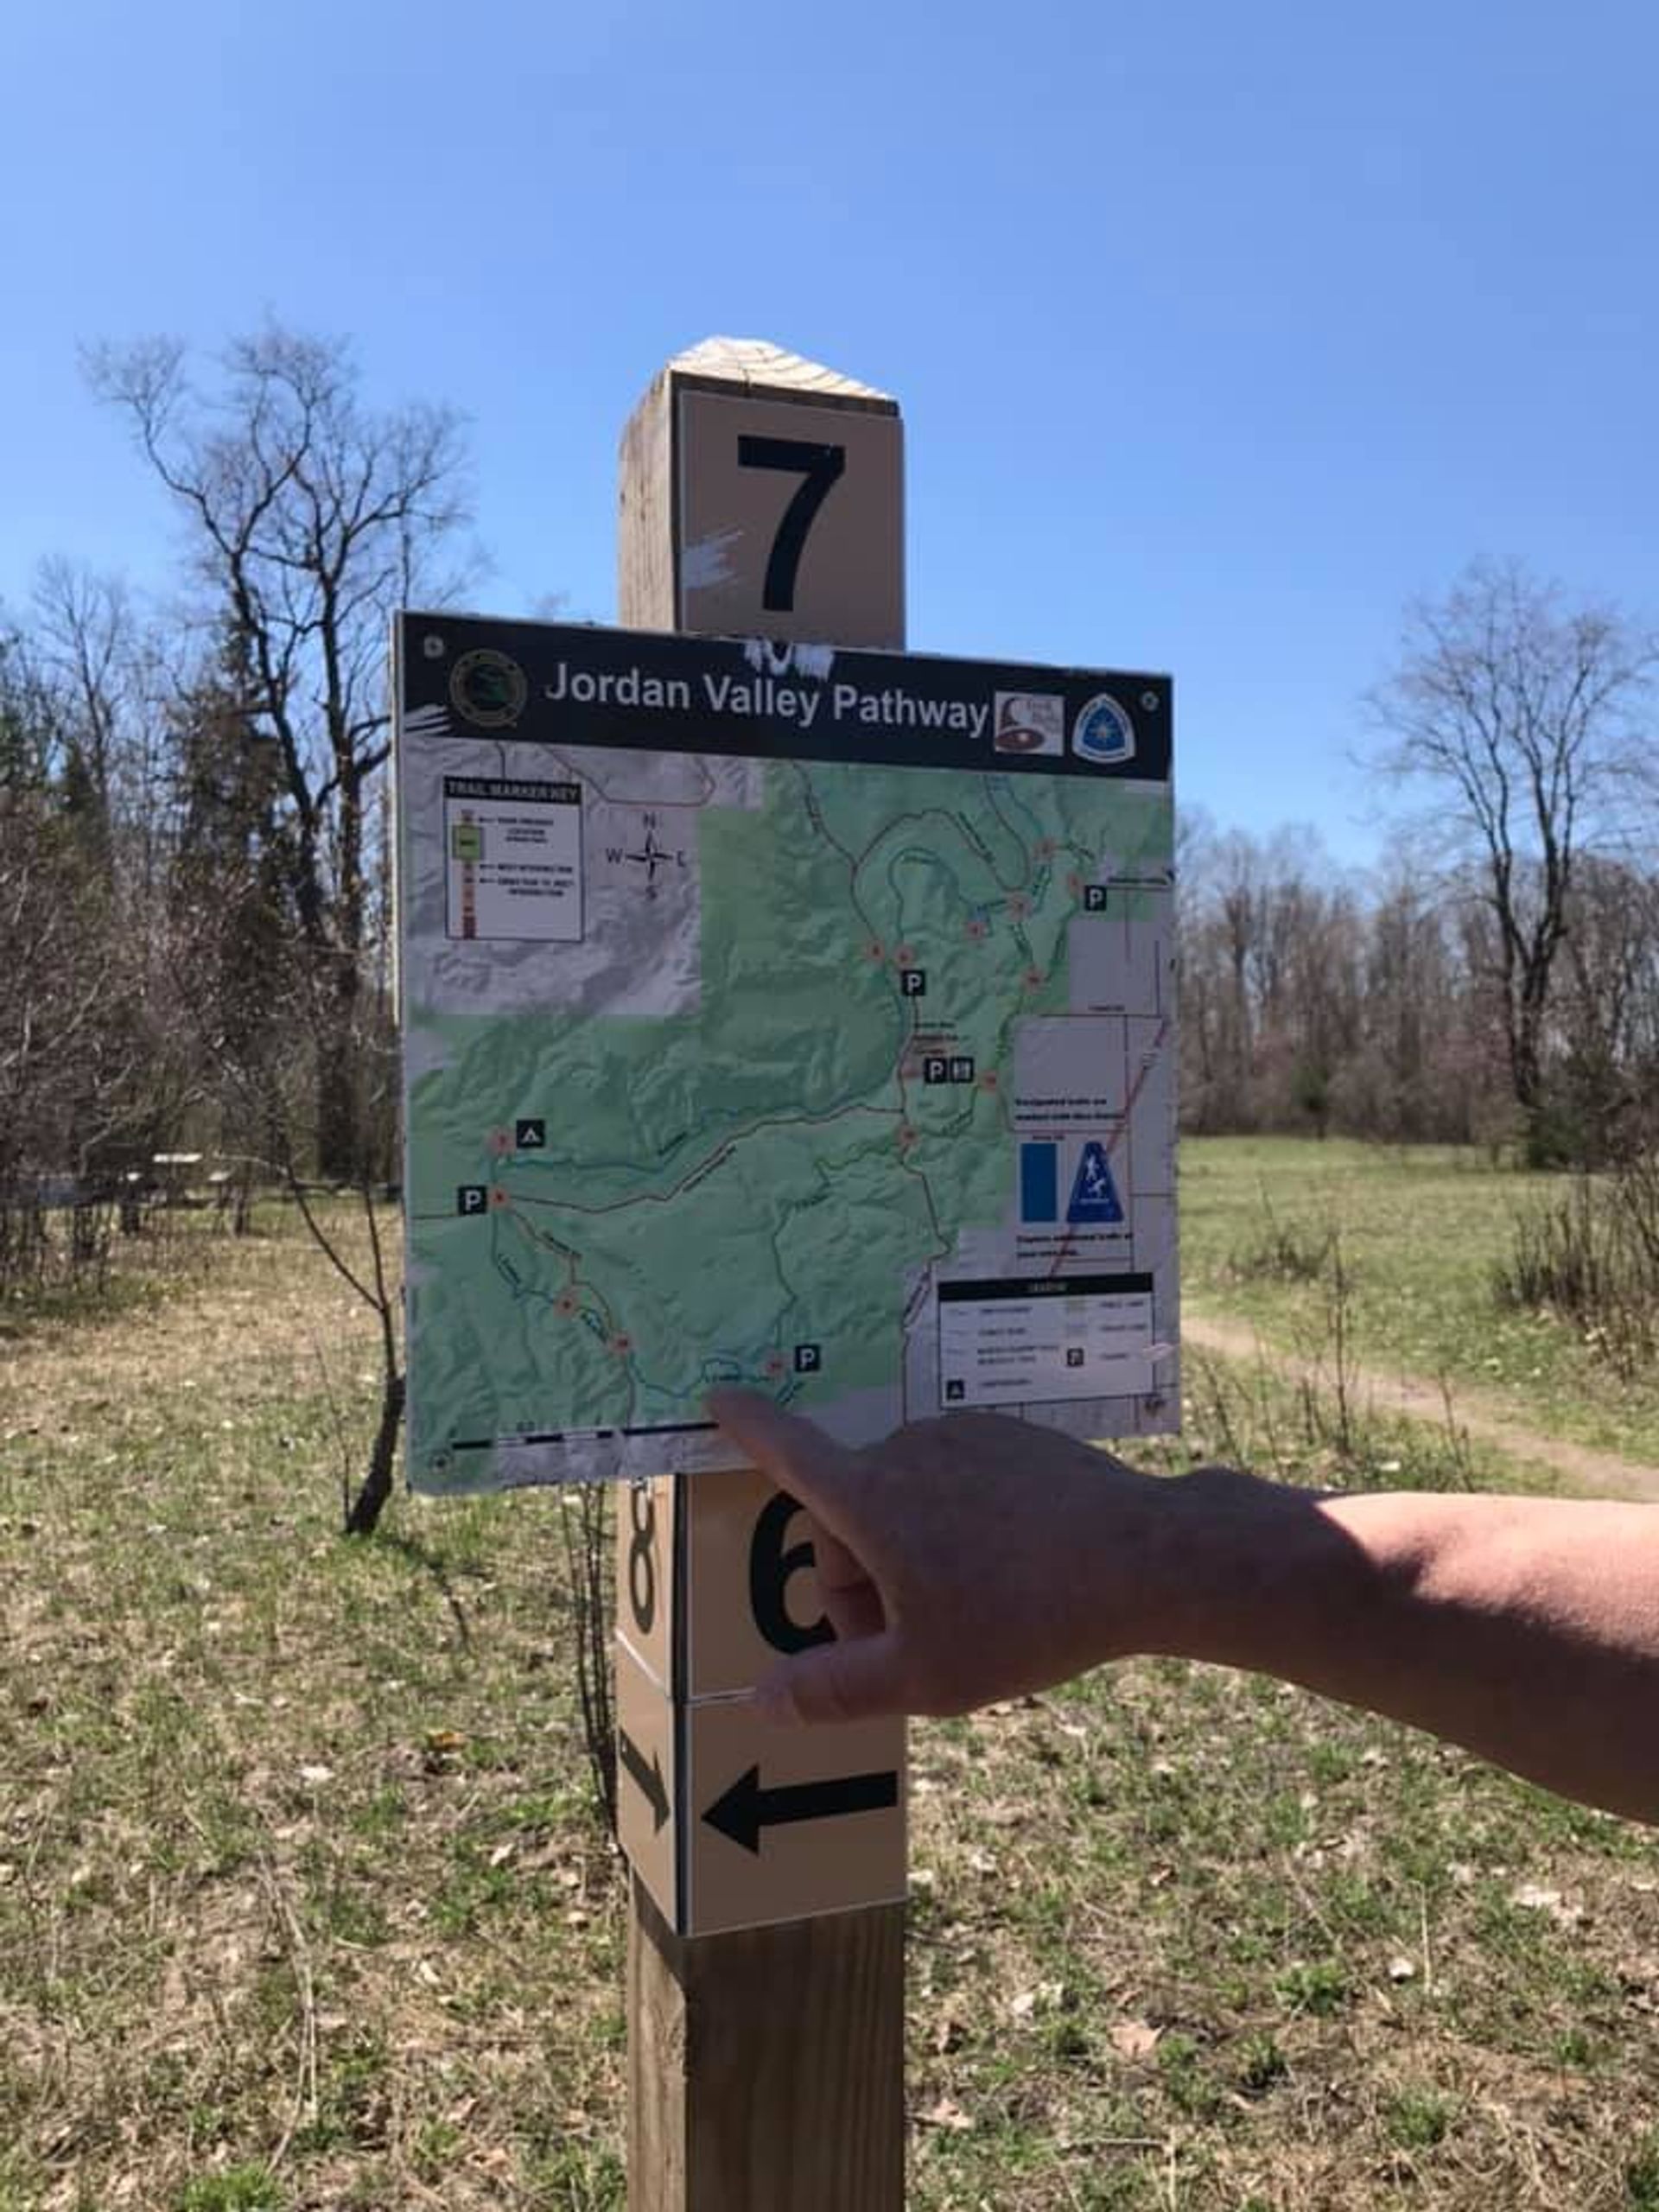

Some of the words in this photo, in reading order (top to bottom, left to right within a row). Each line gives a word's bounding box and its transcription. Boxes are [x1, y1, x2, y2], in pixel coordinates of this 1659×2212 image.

[738, 435, 845, 612] 7
[547, 663, 690, 709] Jordan
[702, 674, 819, 728] Valley
[834, 684, 989, 739] Pathway
[606, 848, 623, 864] W
[630, 1478, 656, 1634] 8
